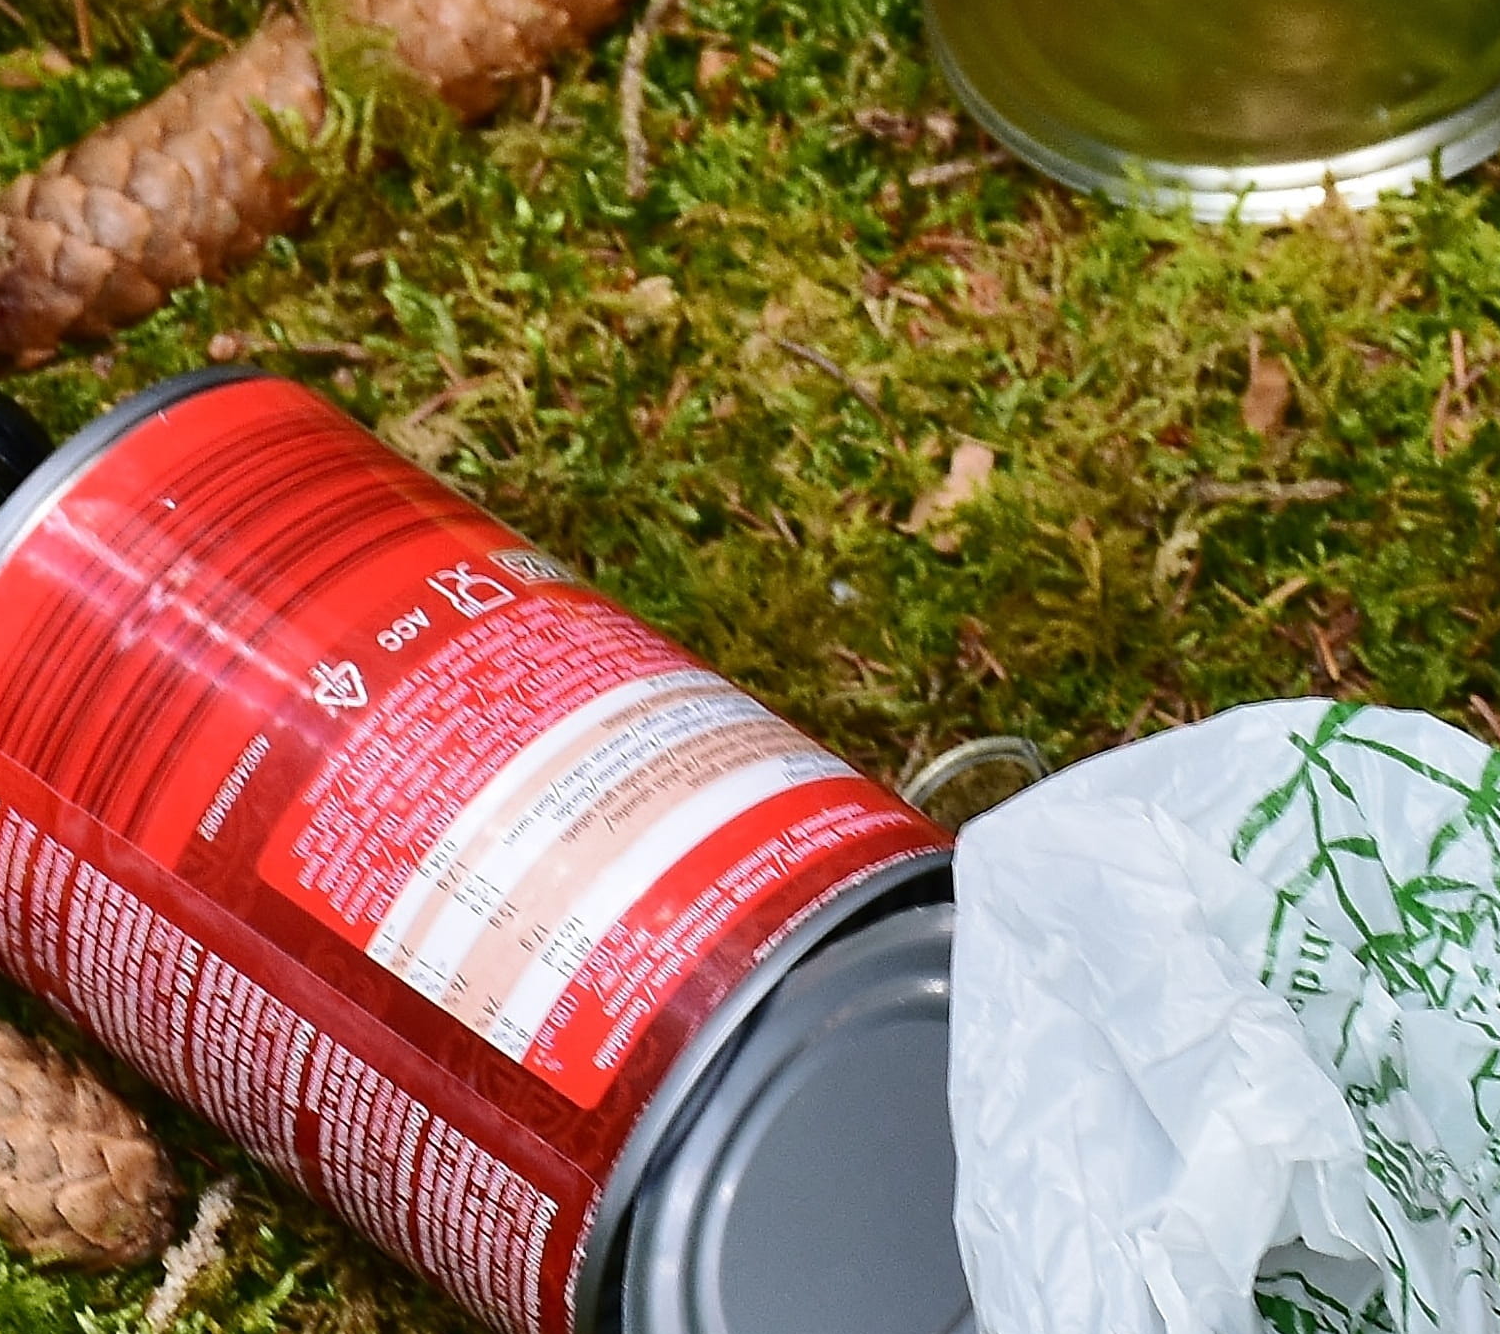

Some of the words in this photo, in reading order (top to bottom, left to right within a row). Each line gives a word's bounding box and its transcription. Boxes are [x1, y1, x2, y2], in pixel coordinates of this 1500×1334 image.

[729, 864, 782, 903] Average
[647, 884, 724, 962] nutritionnelles
[679, 896, 738, 957] nutritional
[172, 969, 192, 997] de
[176, 936, 203, 975] Lait
[647, 947, 691, 992] values
[168, 993, 187, 1033] coco
[599, 955, 653, 1019] moyennes
[592, 995, 652, 1071] Gemiddelde
[397, 1100, 429, 1200] Coconutmilk
[525, 1195, 560, 1319] Kokosnussmilch
